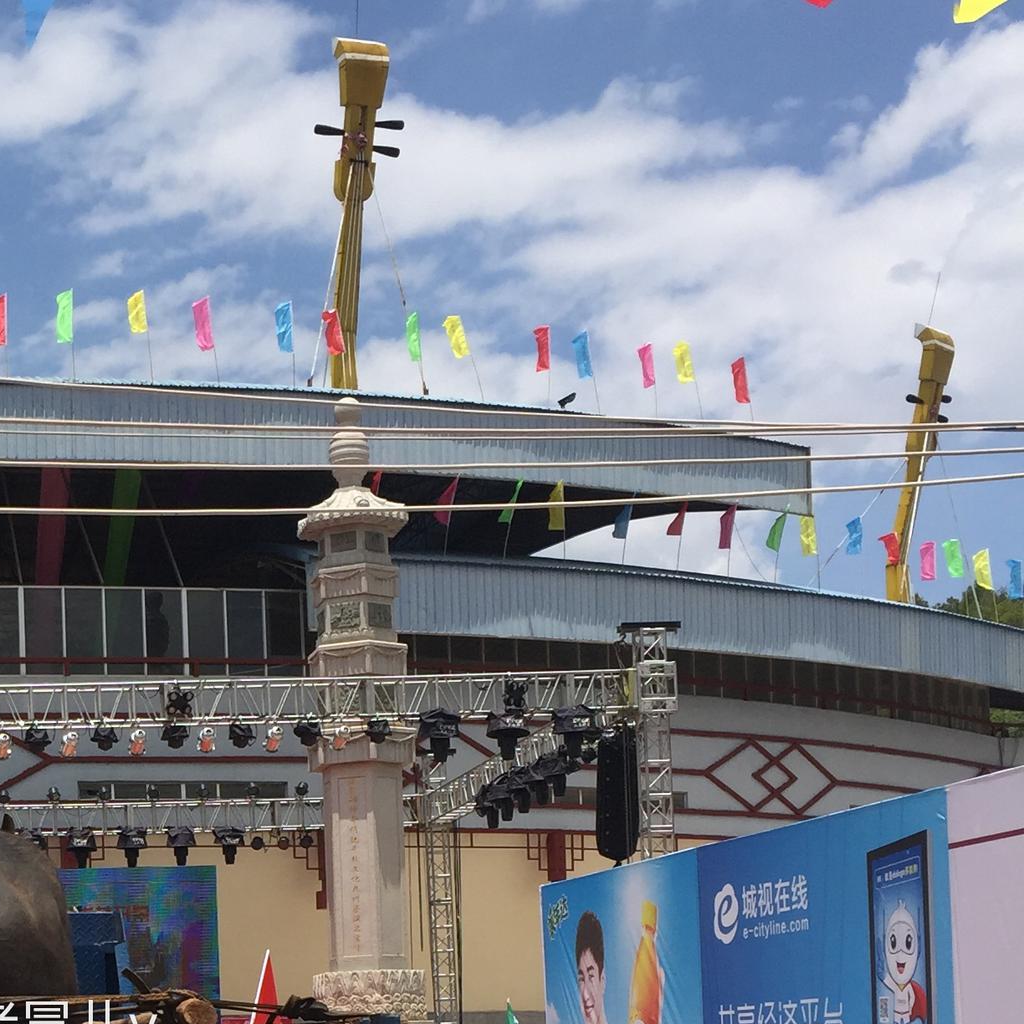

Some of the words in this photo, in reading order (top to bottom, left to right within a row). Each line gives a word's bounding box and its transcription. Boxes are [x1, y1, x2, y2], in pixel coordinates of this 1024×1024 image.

[742, 874, 809, 919] 城视在线
[742, 917, 809, 939] e-cityline.com
